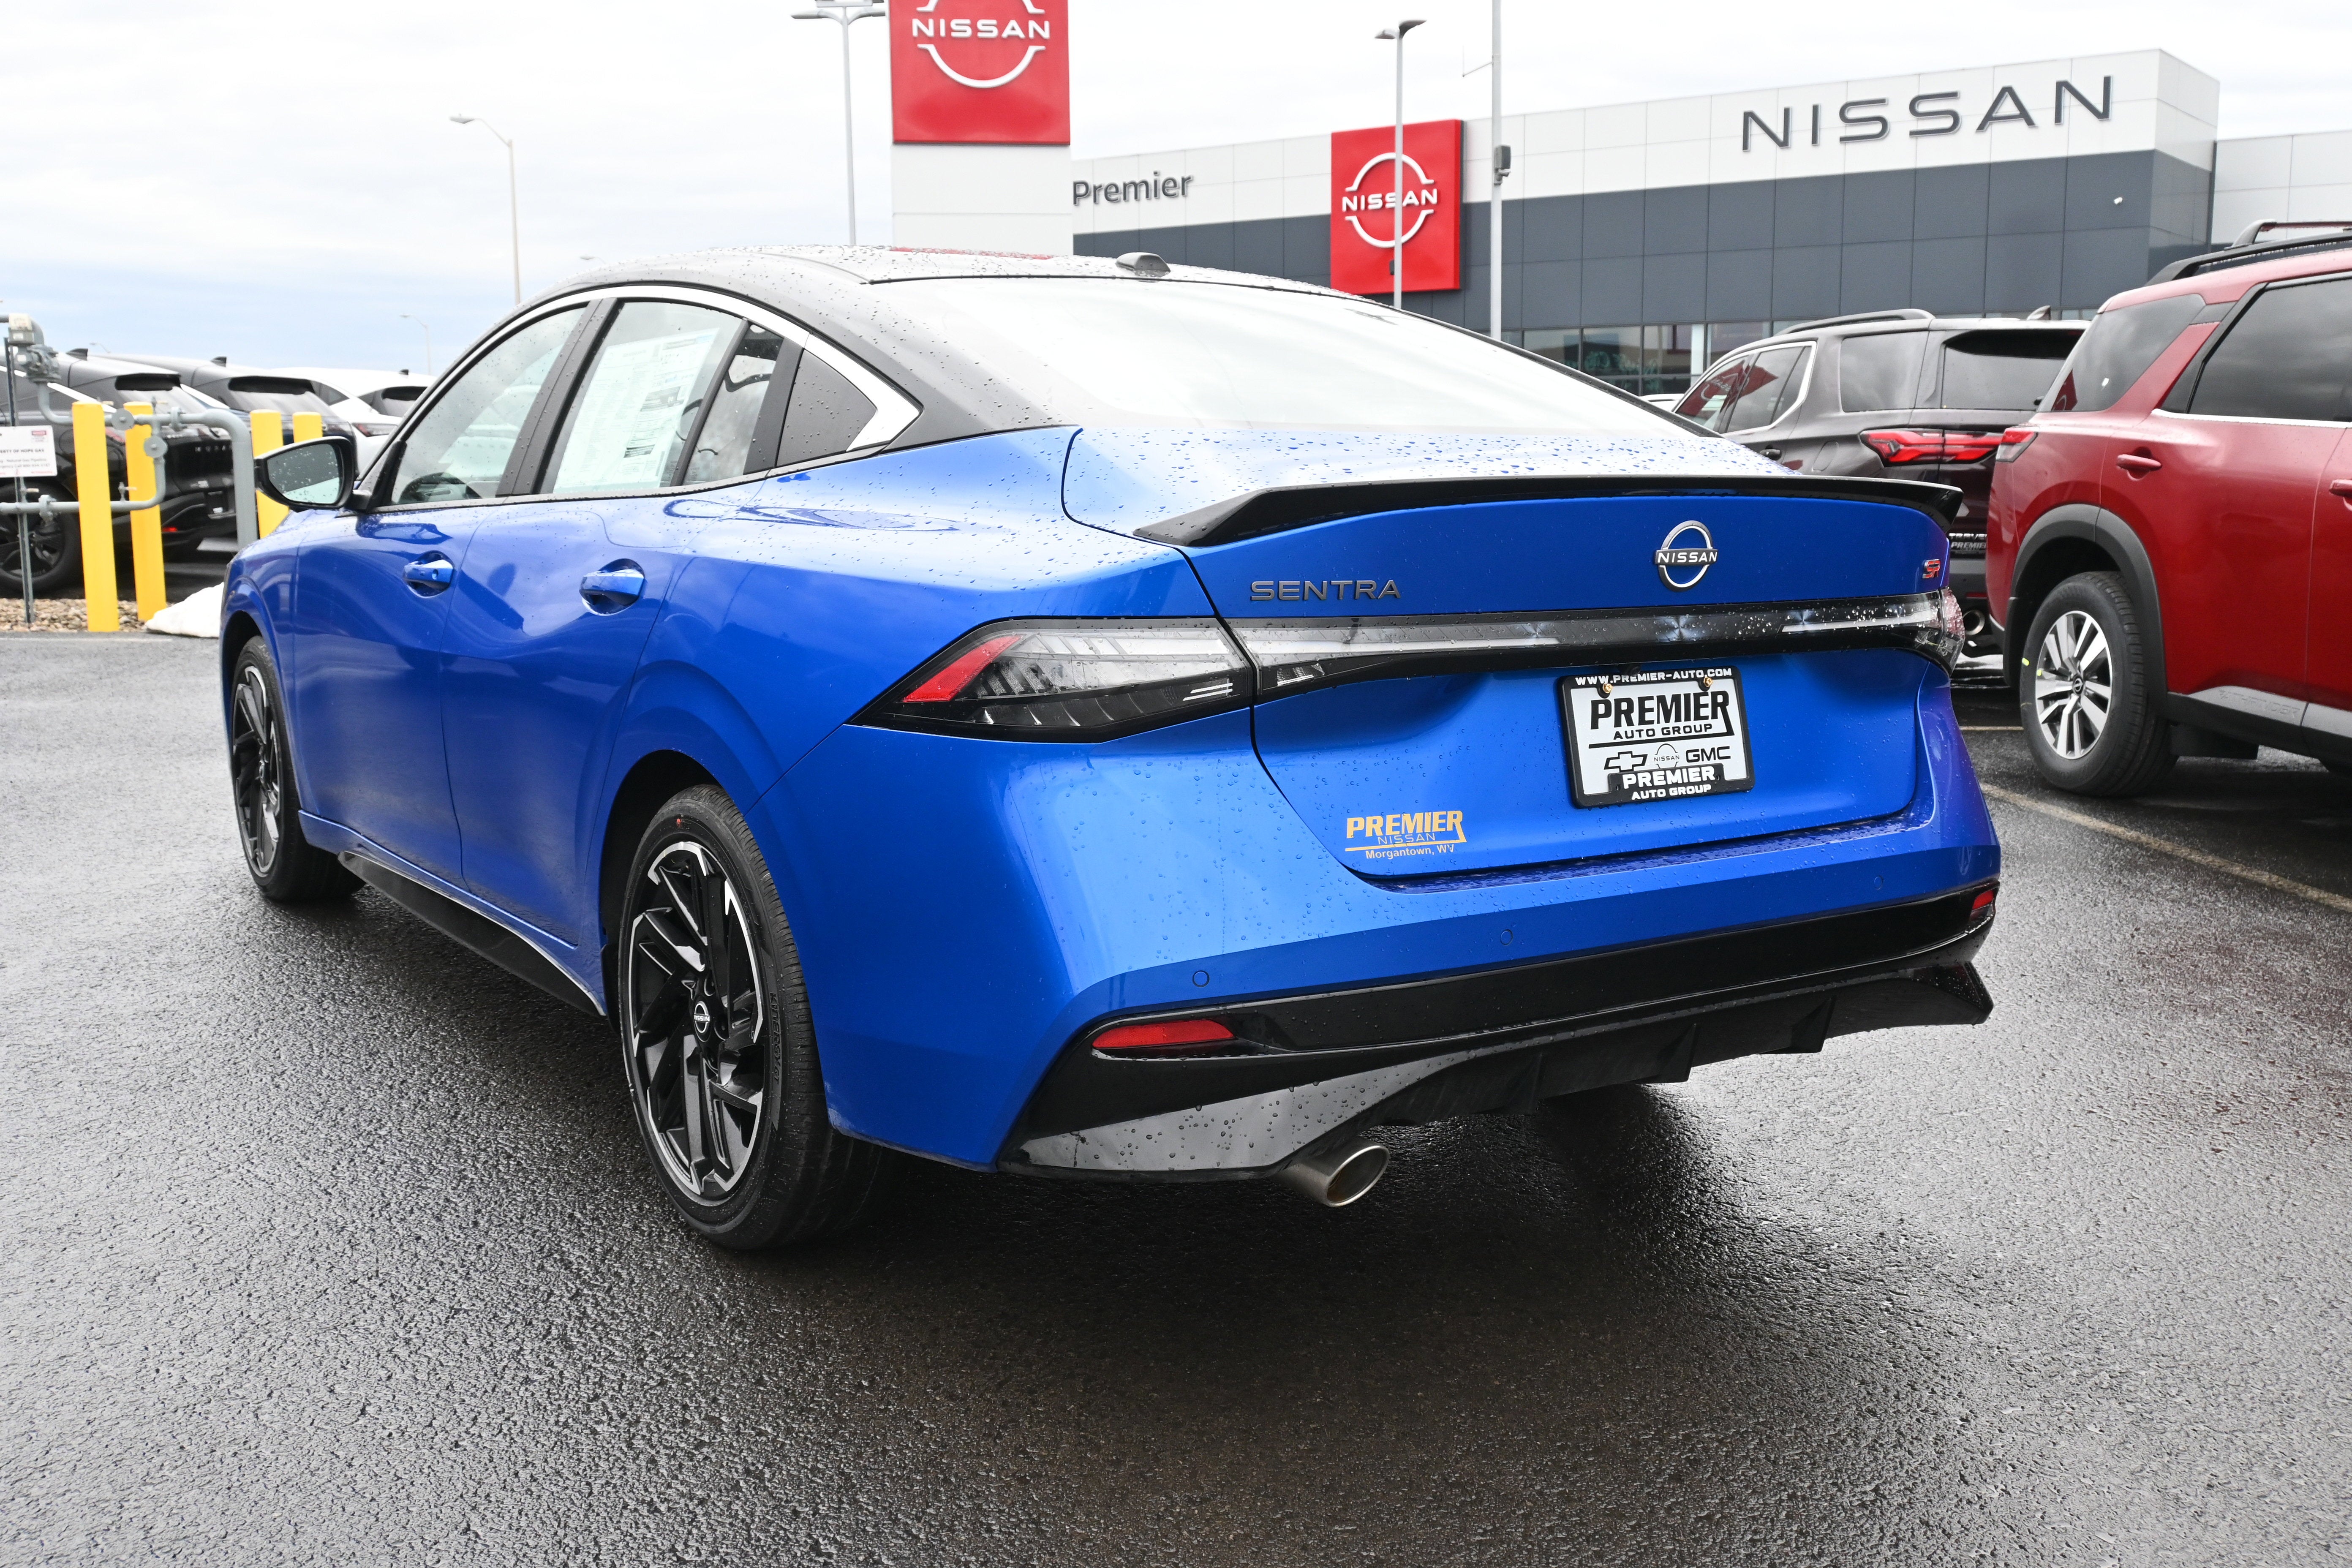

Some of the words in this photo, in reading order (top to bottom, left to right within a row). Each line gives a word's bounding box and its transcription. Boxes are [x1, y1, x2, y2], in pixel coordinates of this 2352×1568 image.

[912, 18, 1050, 40] NISSAN
[1742, 75, 2112, 152] NISSAN
[1073, 170, 1193, 207] Premier
[1341, 188, 1437, 212] NISSAN
[1658, 552, 1718, 563] NISSAN
[1922, 559, 1941, 579] SR
[1250, 580, 1401, 601] SENTRA
[1575, 668, 1732, 686] WWW.PREMIER-AUTO.COM
[1590, 690, 1731, 730] PREMIER
[1613, 728, 1656, 740] AUTO
[1661, 723, 1713, 736] GROUP
[1685, 746, 1731, 763] GMC
[1622, 765, 1716, 789] PREMIER
[1631, 789, 1666, 800] AUTO
[1669, 784, 1712, 796] GROUP
[1346, 810, 1464, 839] PREMIER
[1377, 833, 1436, 845] NISSAN
[1365, 846, 1435, 860] Morgantown,
[1436, 844, 1455, 854] WV
